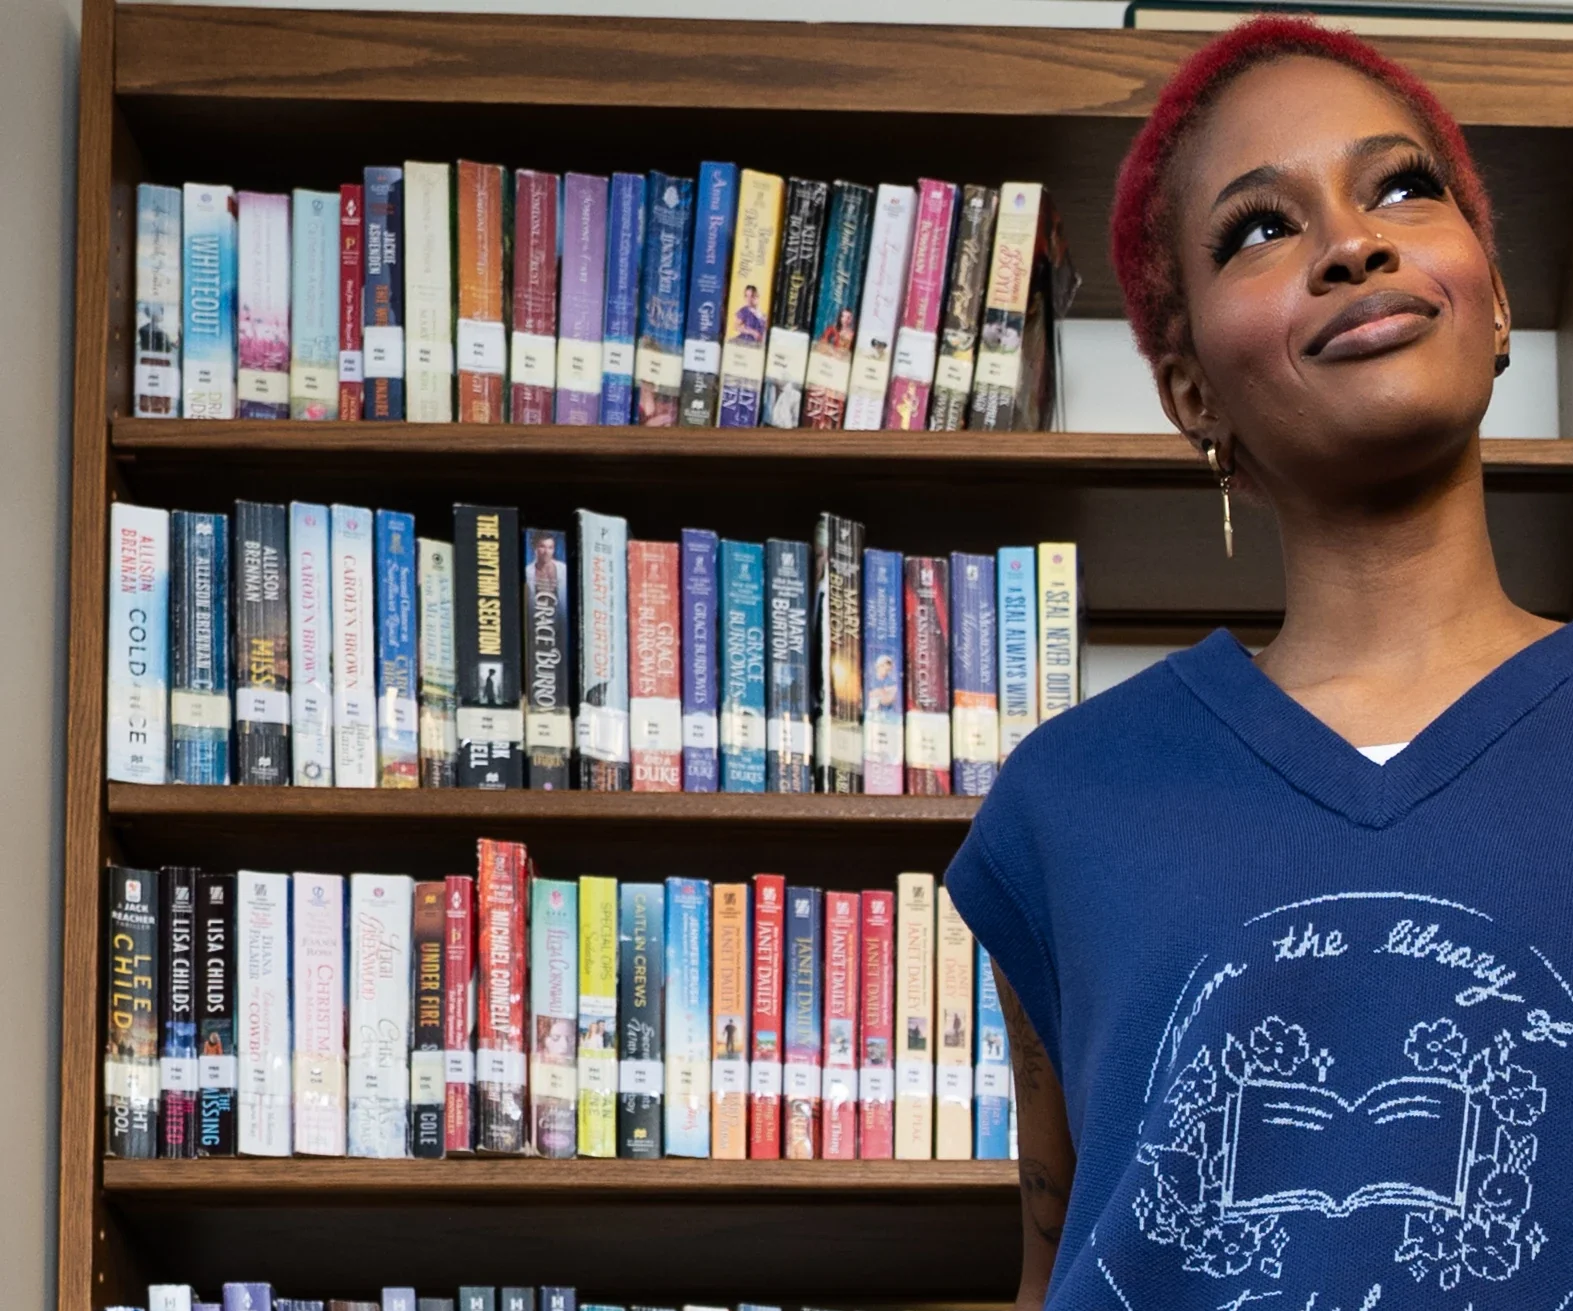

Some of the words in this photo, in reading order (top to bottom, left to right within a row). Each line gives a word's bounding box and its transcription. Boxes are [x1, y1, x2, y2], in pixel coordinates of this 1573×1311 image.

[368, 223, 382, 275] ASHENDEN
[191, 235, 222, 337] WHITEOUT
[476, 514, 500, 538] THE
[121, 528, 137, 593] BRENNAN
[139, 535, 155, 592] ALLISON
[244, 540, 261, 601] BRENNAN
[263, 545, 279, 600] ALLISON
[477, 540, 500, 596] RHYTHM
[343, 555, 358, 627] CAROLYN
[129, 608, 147, 677] COLD
[478, 598, 502, 655] SECTION
[637, 605, 656, 694] BURROWES
[655, 621, 674, 677] GRACE
[344, 632, 360, 690] BROWN
[172, 919, 190, 952] LISA
[491, 910, 510, 965] MICHAEL
[634, 894, 647, 951] CAITLIN
[830, 928, 847, 968] JANET
[113, 933, 134, 1030] CHILD
[133, 954, 153, 1012] LEE
[172, 958, 191, 1013] CHILDS
[420, 942, 441, 990] UNDER
[633, 955, 647, 1008] CREWS
[1272, 923, 1349, 962] the
[1373, 919, 1526, 1007] library
[420, 995, 441, 1027] FIRE
[491, 968, 511, 1033] CONNELLY
[830, 971, 847, 1017] DAILEY
[420, 1112, 438, 1145] COLE
